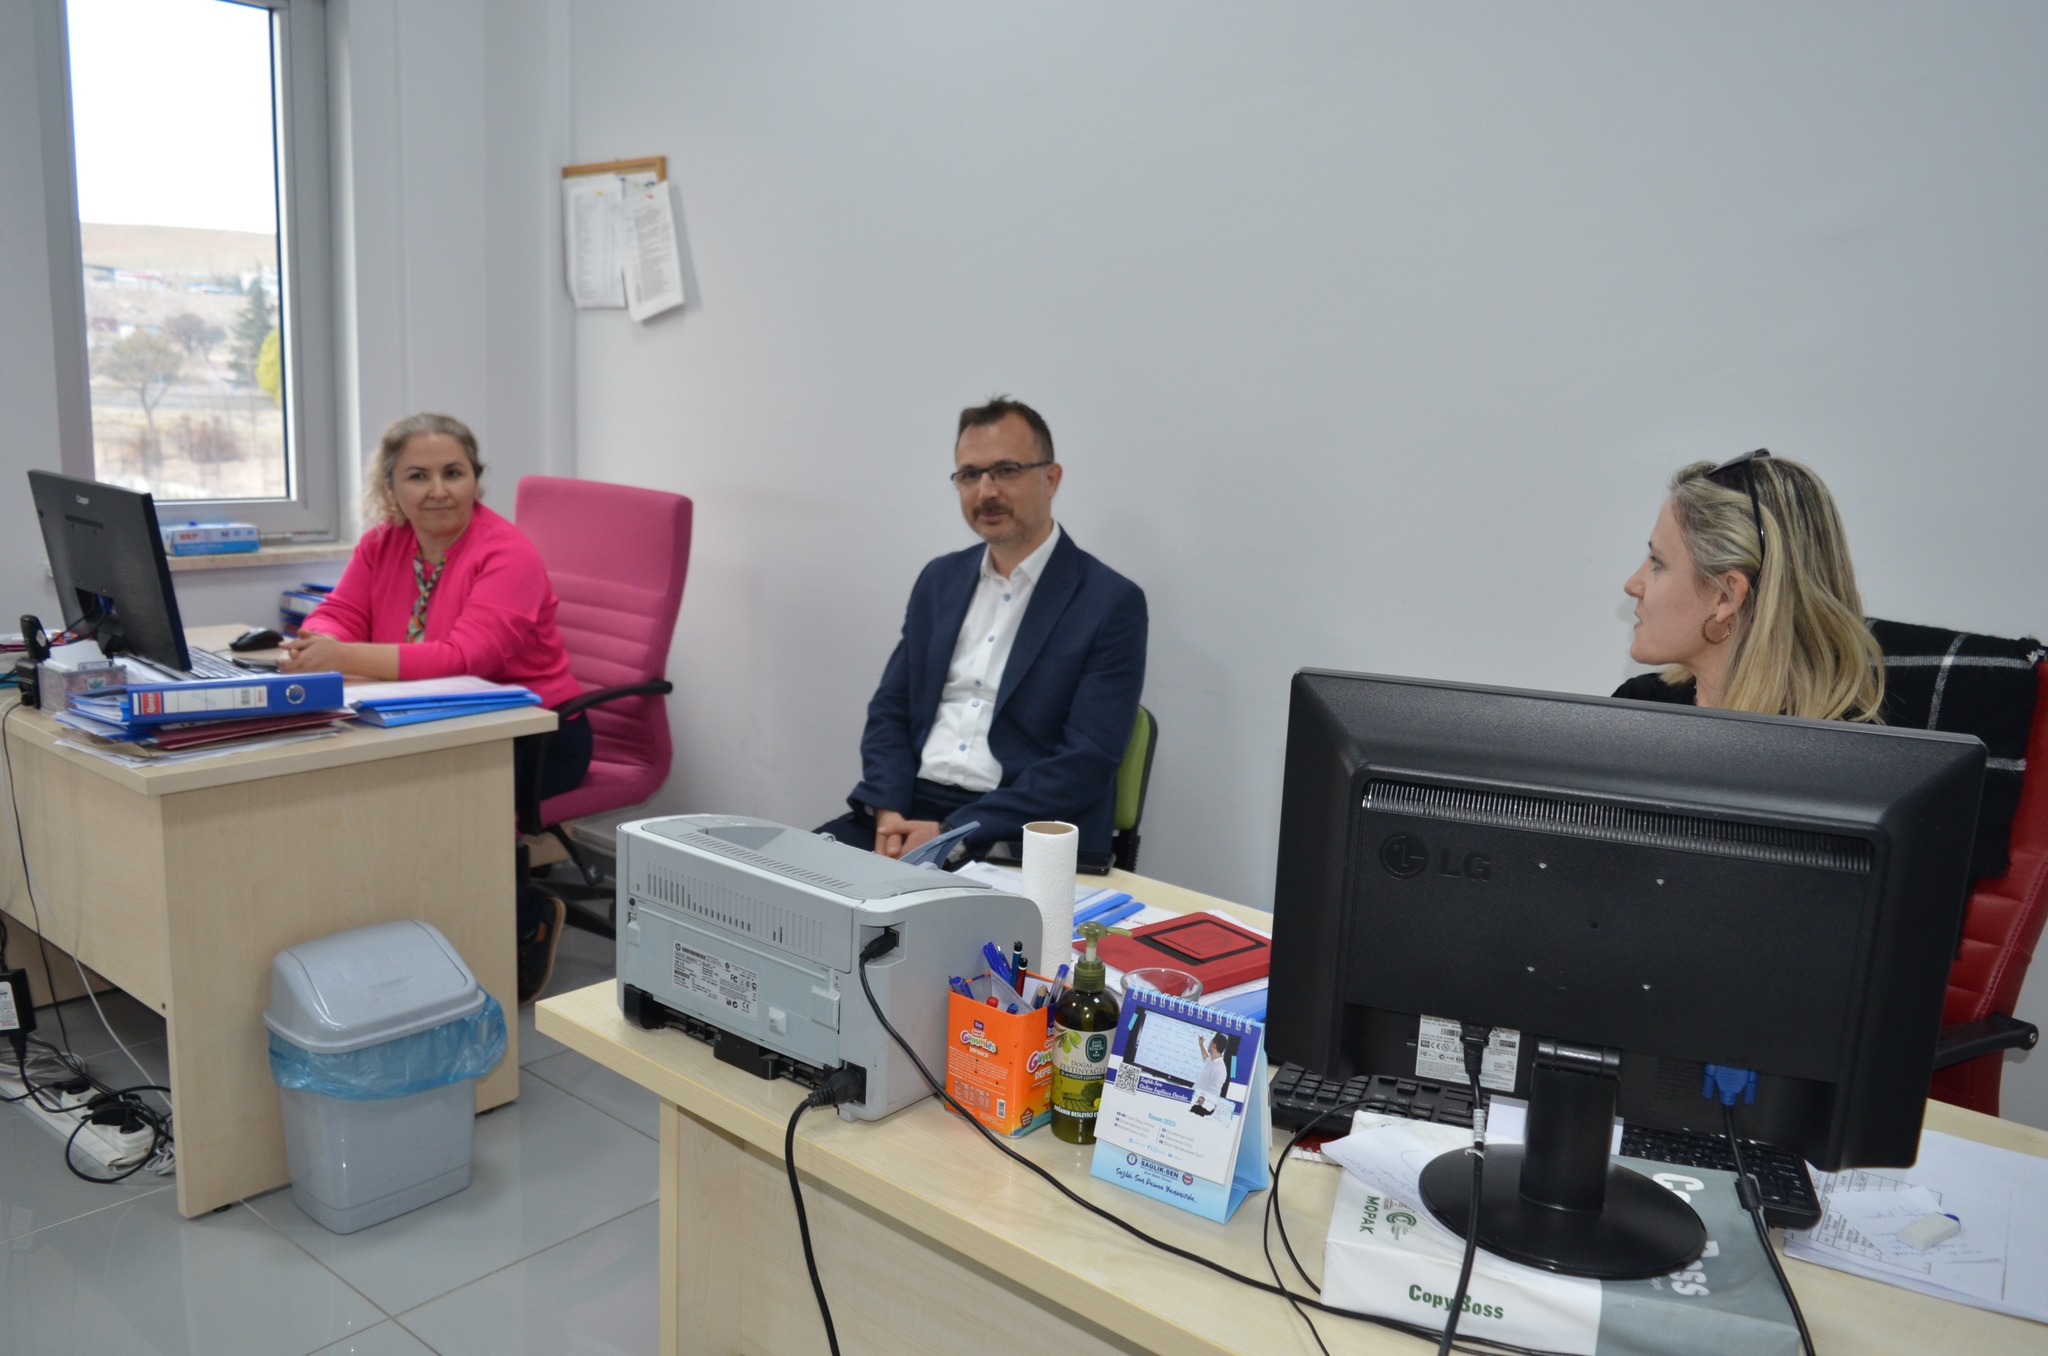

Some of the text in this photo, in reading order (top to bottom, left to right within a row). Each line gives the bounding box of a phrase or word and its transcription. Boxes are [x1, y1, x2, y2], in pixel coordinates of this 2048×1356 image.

[1439, 848, 1492, 881] LG
[960, 1030, 997, 1053] Gummies
[1034, 1065, 1052, 1080] DEFE
[1359, 1195, 1380, 1235] MOPAK
